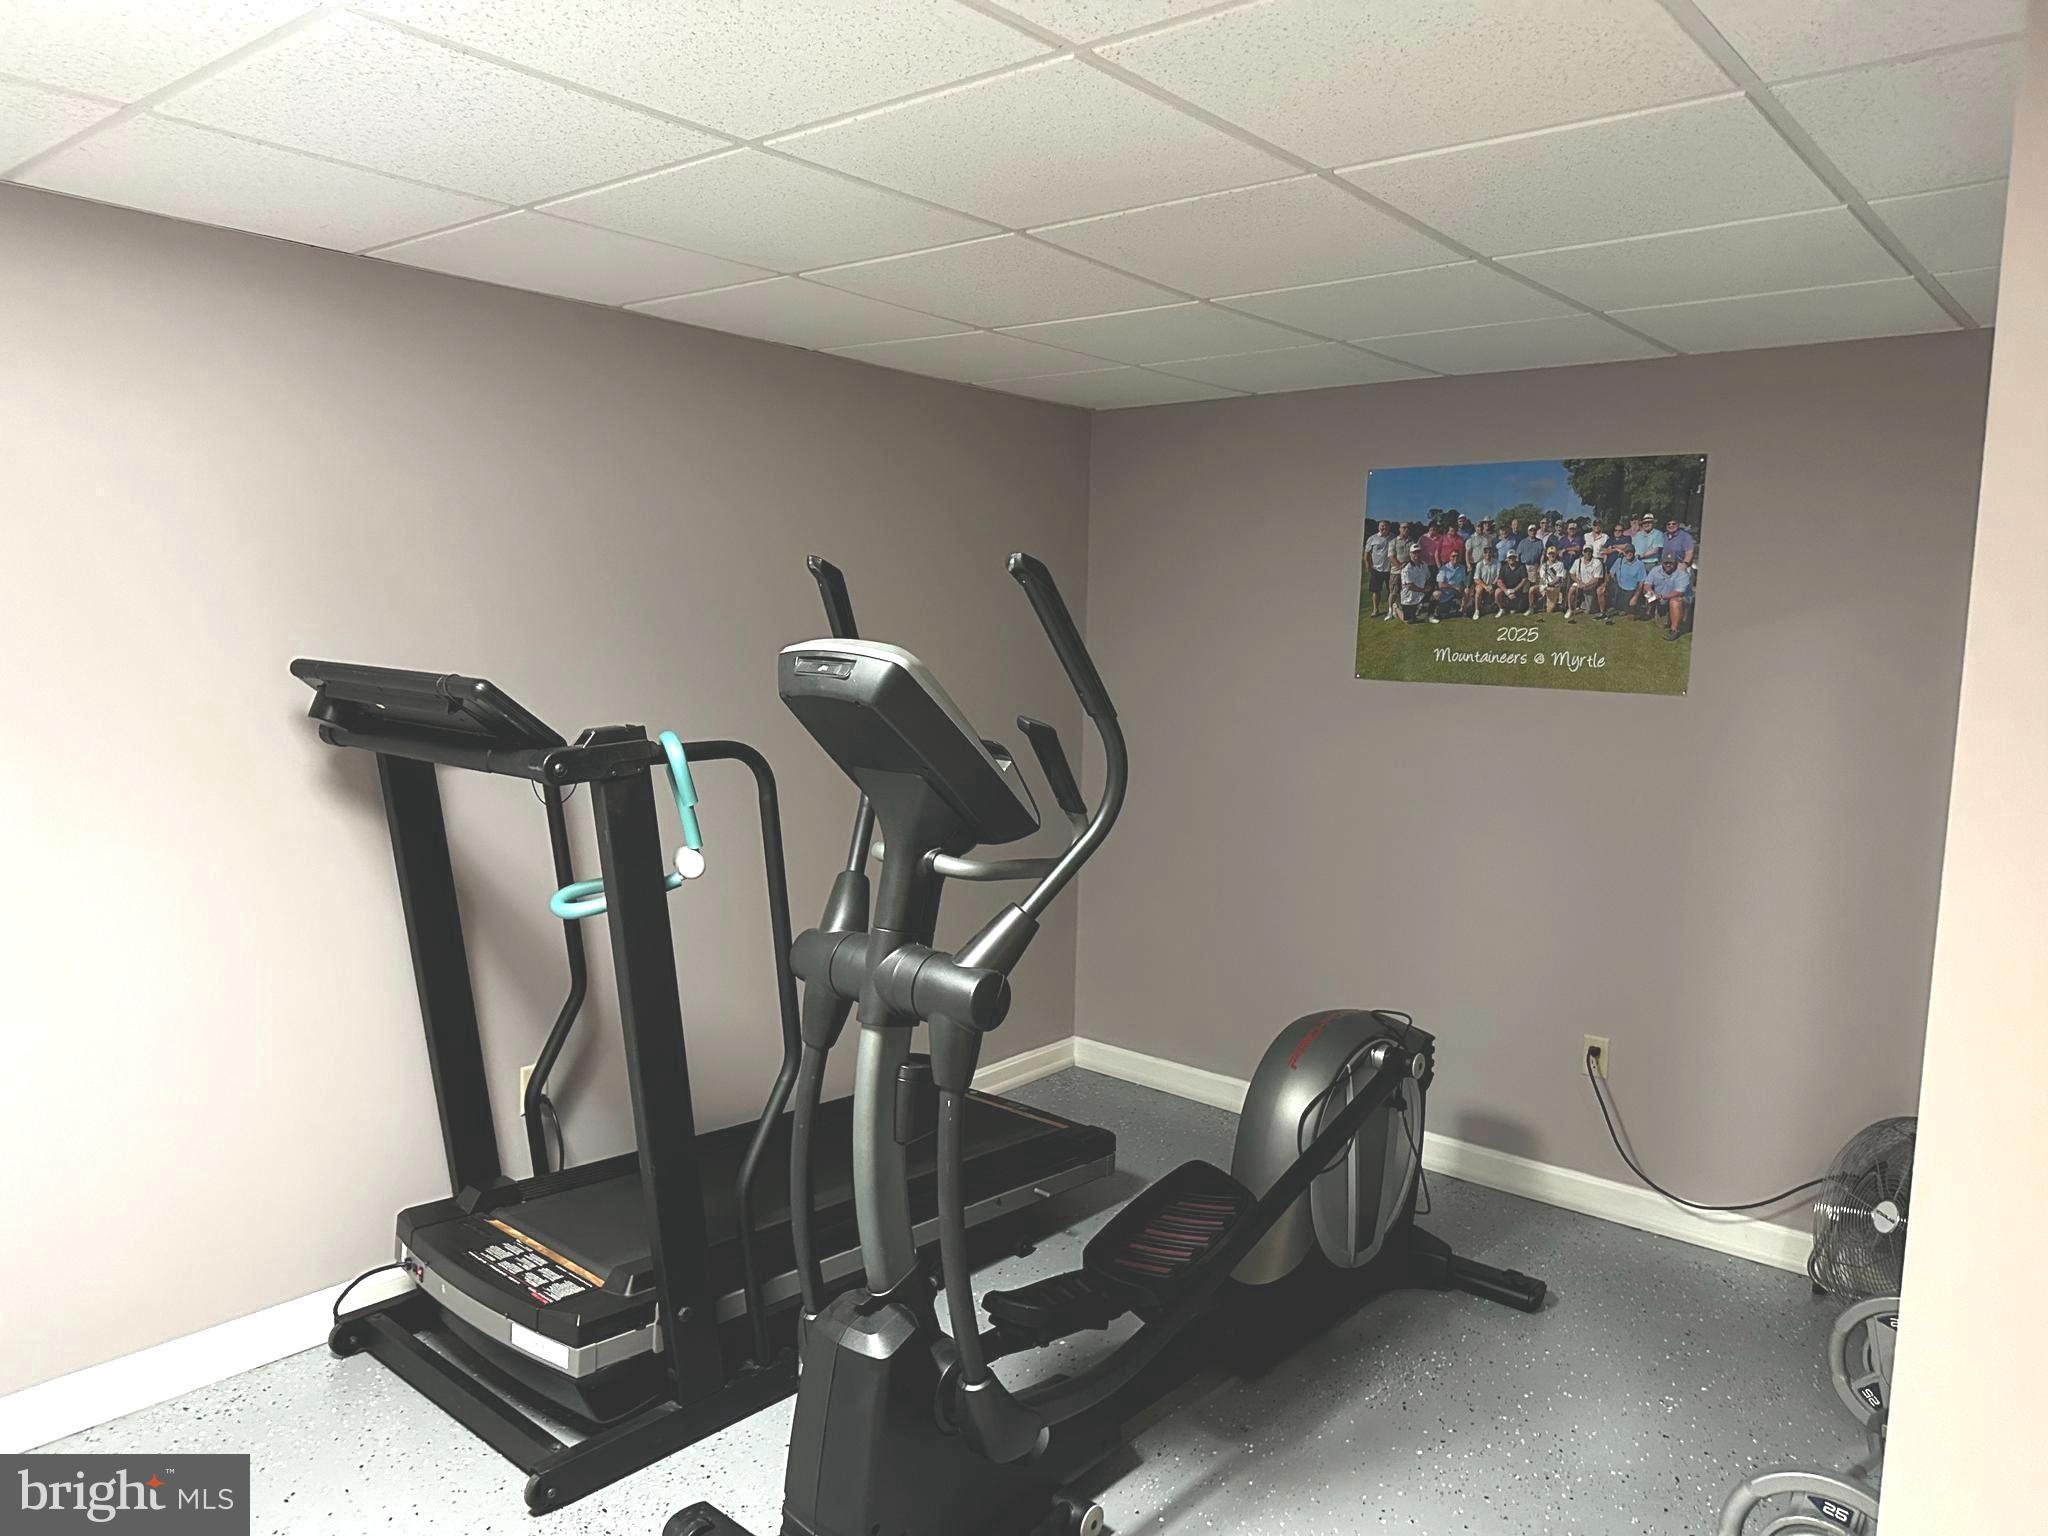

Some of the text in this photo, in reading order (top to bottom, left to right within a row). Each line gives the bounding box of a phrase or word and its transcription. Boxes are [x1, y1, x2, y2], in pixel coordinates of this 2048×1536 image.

[1496, 626, 1539, 642] 2025
[1433, 647, 1606, 673] Mountaineers @ Myrtle
[1862, 1388, 1881, 1407] 25
[1822, 1501, 1850, 1522] 25
